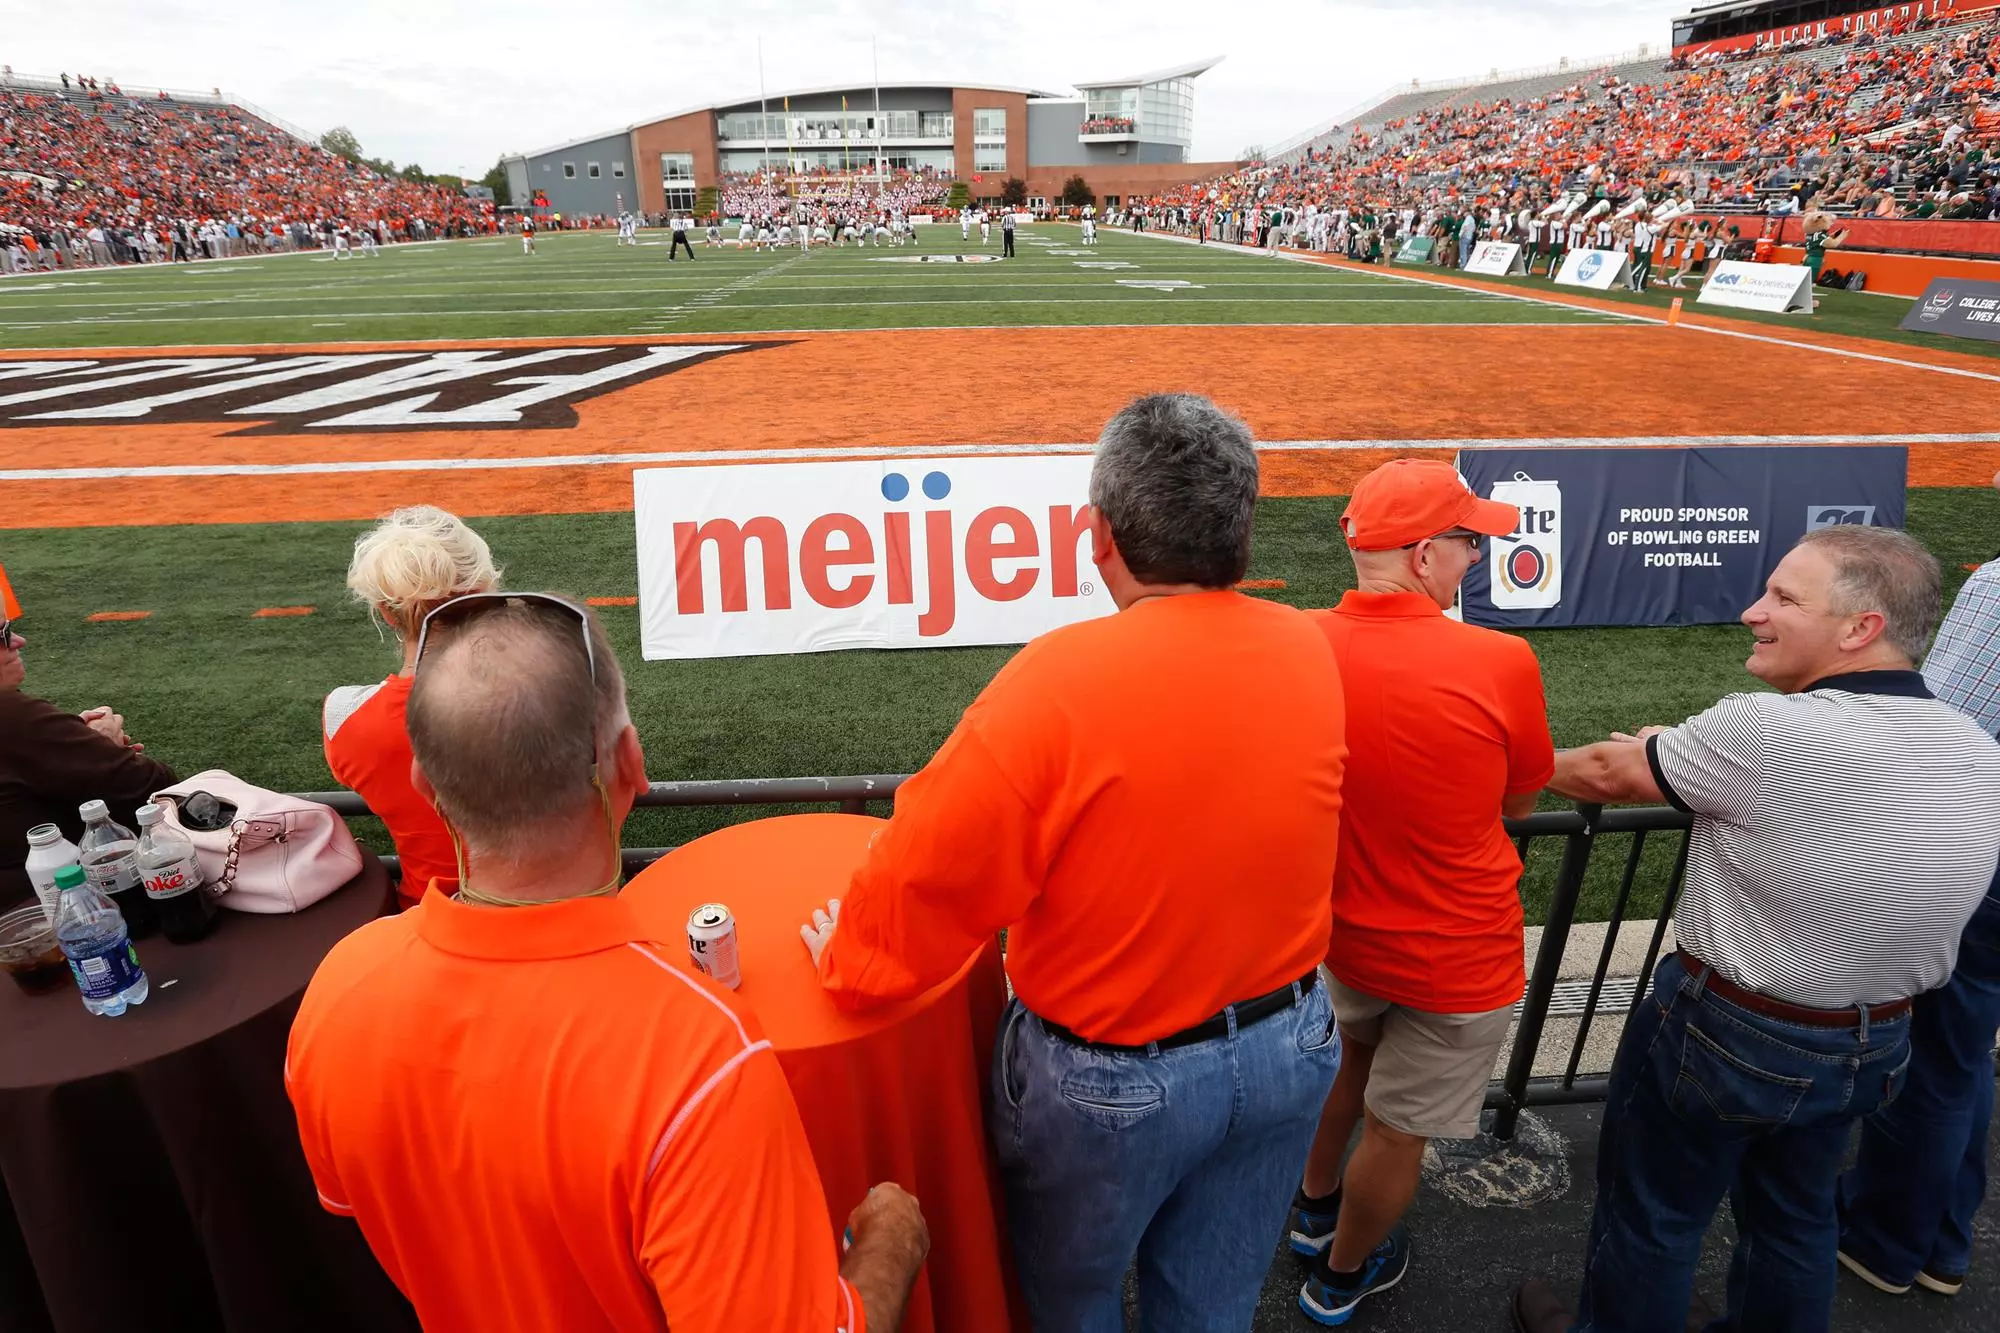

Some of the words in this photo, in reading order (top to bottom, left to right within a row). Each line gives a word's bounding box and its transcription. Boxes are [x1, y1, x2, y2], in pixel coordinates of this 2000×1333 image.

[1756, 21, 1829, 48] FALCON
[1959, 297, 1998, 310] COLLEGE
[1966, 310, 1994, 322] LIVES
[1620, 508, 1674, 523] PROUD
[1678, 507, 1749, 522] SPONSOR
[1607, 531, 1629, 545] OF
[1632, 530, 1703, 545] BOWLING
[1706, 529, 1760, 544] GREEN
[673, 471, 1094, 637] meijer
[1644, 552, 1722, 567] FOOTBALL
[158, 867, 180, 879] Diet
[145, 874, 184, 892] oke
